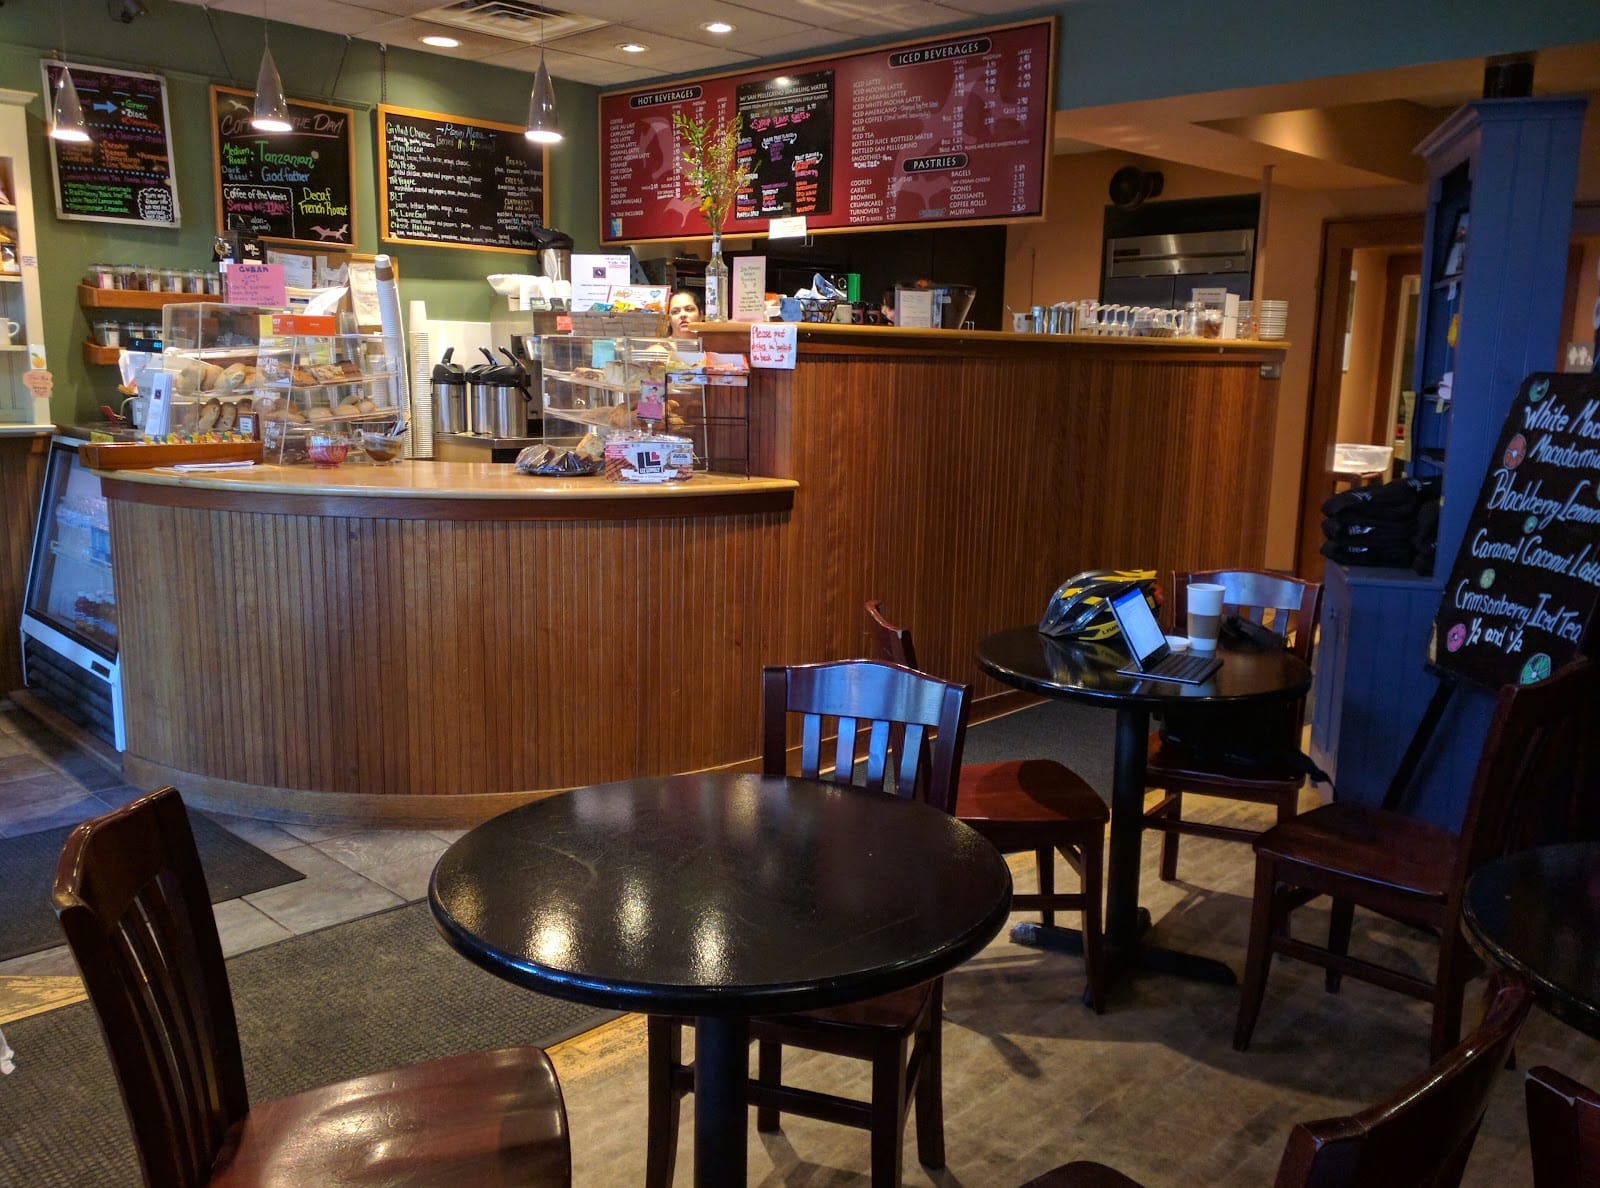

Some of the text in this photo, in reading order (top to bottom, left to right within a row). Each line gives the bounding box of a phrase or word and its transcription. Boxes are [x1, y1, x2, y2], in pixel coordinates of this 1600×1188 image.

[899, 42, 979, 64] ICED BEVERAGES
[866, 78, 881, 86] LATTE
[866, 85, 886, 94] MOCHA
[637, 90, 694, 105] HOT BEVERAGES
[853, 90, 906, 103] ICED CARAMEL LATTE
[866, 100, 883, 109] WHITE
[883, 97, 905, 106] MOCHA
[906, 95, 921, 103] LATTE
[126, 108, 148, 120] Black
[852, 110, 865, 118] ICED
[865, 105, 898, 116] AMERICANO
[852, 118, 865, 126] ICED
[865, 115, 882, 124] COFFEE
[409, 126, 432, 140] Cheese
[852, 132, 863, 140] ICED
[852, 132, 934, 148] BOTTLED JUICE BOTTLED WATER
[254, 140, 315, 170] Tanzanian
[852, 142, 918, 155] BOTTLED SAN PELLEGRINO
[222, 165, 241, 174] Dark
[913, 156, 957, 170] PASTRIES
[224, 188, 248, 200] Coffee
[248, 188, 256, 199] of
[303, 187, 332, 202] Decaf
[389, 192, 406, 202] BLT
[950, 192, 984, 200] CROISSANTS
[298, 200, 348, 216] French Roast
[850, 200, 883, 208] CRUMBCAKES
[950, 208, 976, 216] MUFFINS
[752, 326, 772, 339] Please
[1524, 394, 1600, 439] White Moc
[1486, 467, 1562, 530] Blackberry
[1472, 528, 1524, 564] Caramel
[1522, 536, 1575, 574] Coconut
[1455, 578, 1582, 644] Crimsonberry Iced Tea
[1484, 625, 1505, 649] and
